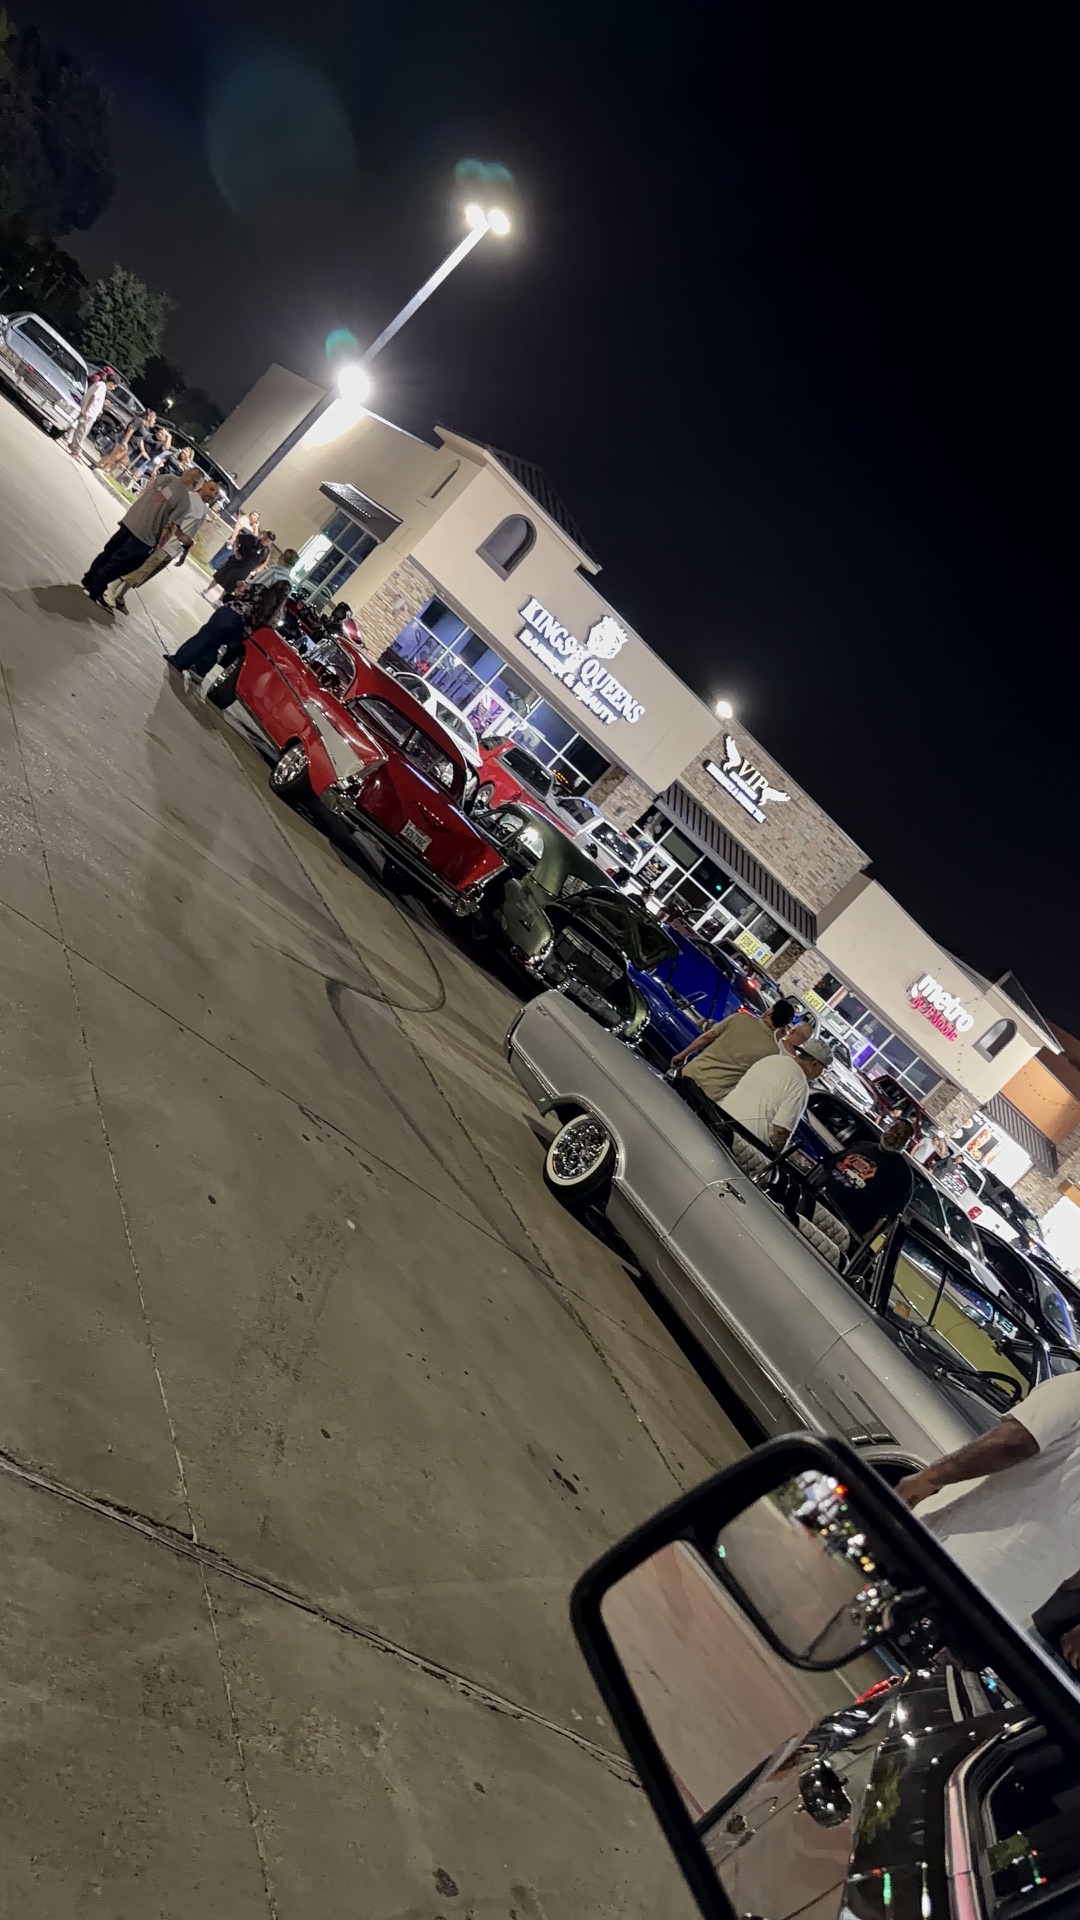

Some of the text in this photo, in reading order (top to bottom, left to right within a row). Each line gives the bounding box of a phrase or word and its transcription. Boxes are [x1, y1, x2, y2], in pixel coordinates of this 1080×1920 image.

[519, 596, 579, 656] KINGS
[580, 658, 646, 724] QUEENS
[738, 758, 769, 790] VIP
[740, 934, 754, 948] FOR
[750, 944, 769, 961] LEE
[910, 993, 927, 1011] by
[912, 974, 975, 1033] metro
